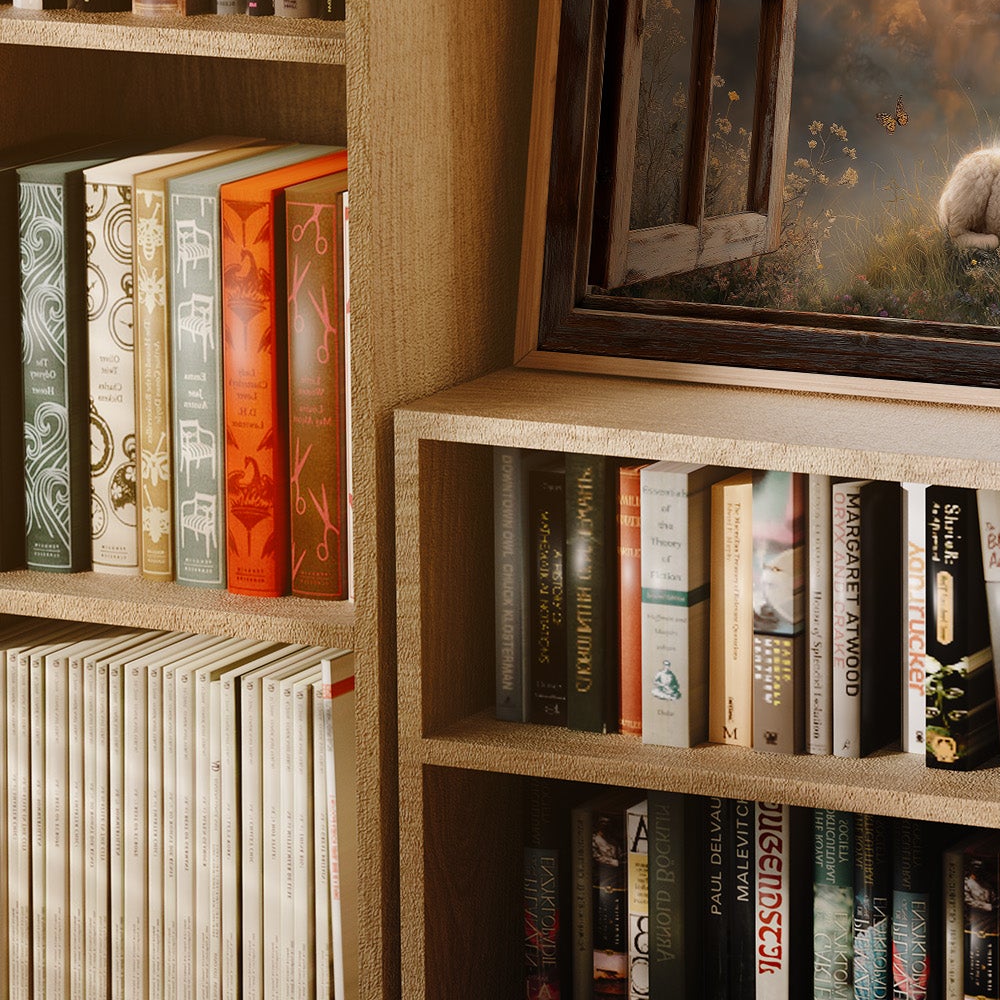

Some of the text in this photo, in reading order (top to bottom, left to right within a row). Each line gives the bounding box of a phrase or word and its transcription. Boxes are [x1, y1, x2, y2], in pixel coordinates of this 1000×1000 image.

[501, 454, 514, 690] DOWNTOWN OWL CHUCK KLOSTERMAN
[651, 537, 682, 550] Theory
[833, 492, 846, 669] ORYX AND CRAKE
[846, 493, 860, 698] MARGARET ATWOOD
[764, 638, 772, 704] MATTHEW
[722, 726, 738, 740] M
[711, 797, 722, 915] PAUL DELVAU
